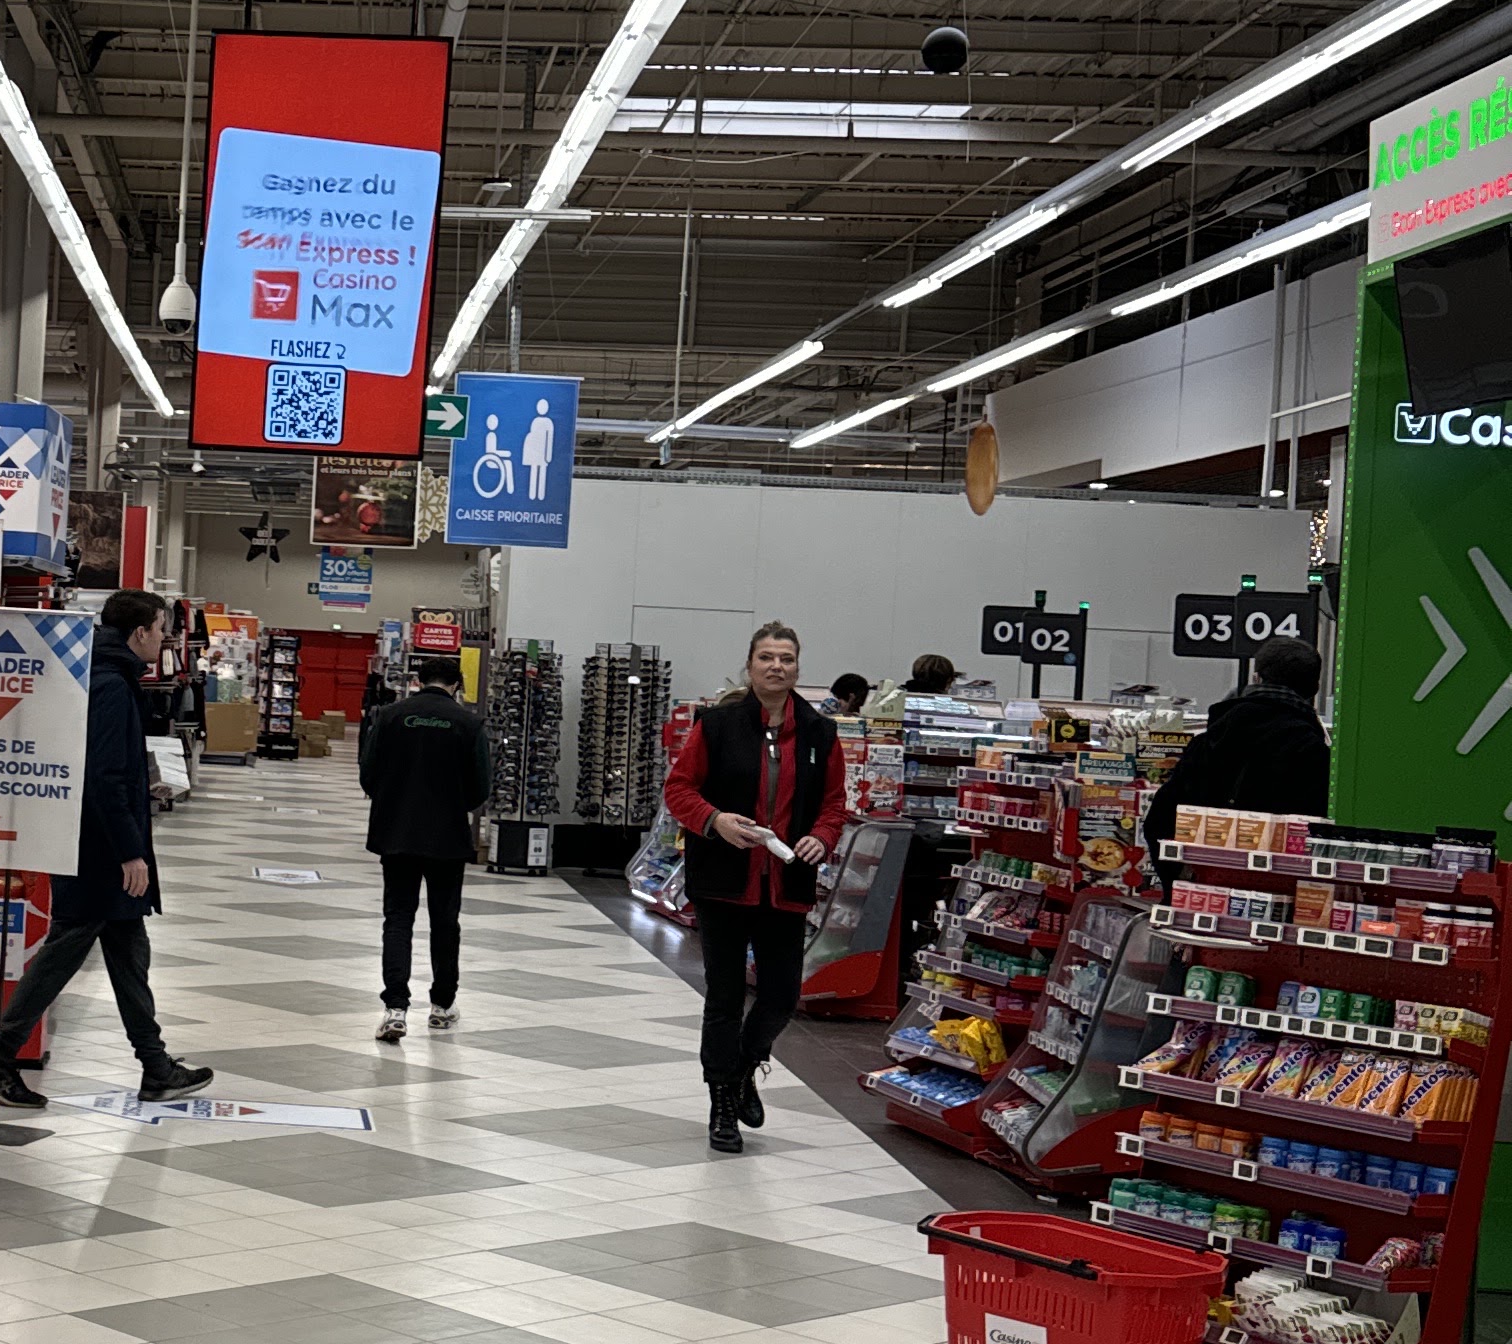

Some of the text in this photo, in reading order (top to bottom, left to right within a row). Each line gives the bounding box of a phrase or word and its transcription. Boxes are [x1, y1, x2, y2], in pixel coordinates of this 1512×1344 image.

[1373, 105, 1461, 191] ACCÈS
[262, 174, 396, 195] Gagnez du
[1425, 187, 1476, 227] Express
[320, 212, 382, 231] avec
[392, 210, 414, 231] le
[295, 231, 400, 267] Express
[313, 269, 397, 291] Casino
[311, 294, 395, 329] Max
[271, 339, 331, 359] FLASHEZ
[330, 466, 350, 475] leurs
[368, 467, 388, 476] bons
[390, 468, 411, 479] plans
[455, 508, 563, 525] CAISSE PRIORITAIRE
[993, 621, 1024, 643] 01
[1185, 613, 1232, 642] 03
[1245, 611, 1300, 640] 04
[1031, 628, 1070, 652] 02
[12, 740, 35, 754] DE
[1081, 759, 1133, 769] BREUVAGES
[1084, 767, 1129, 776] MIRACLES
